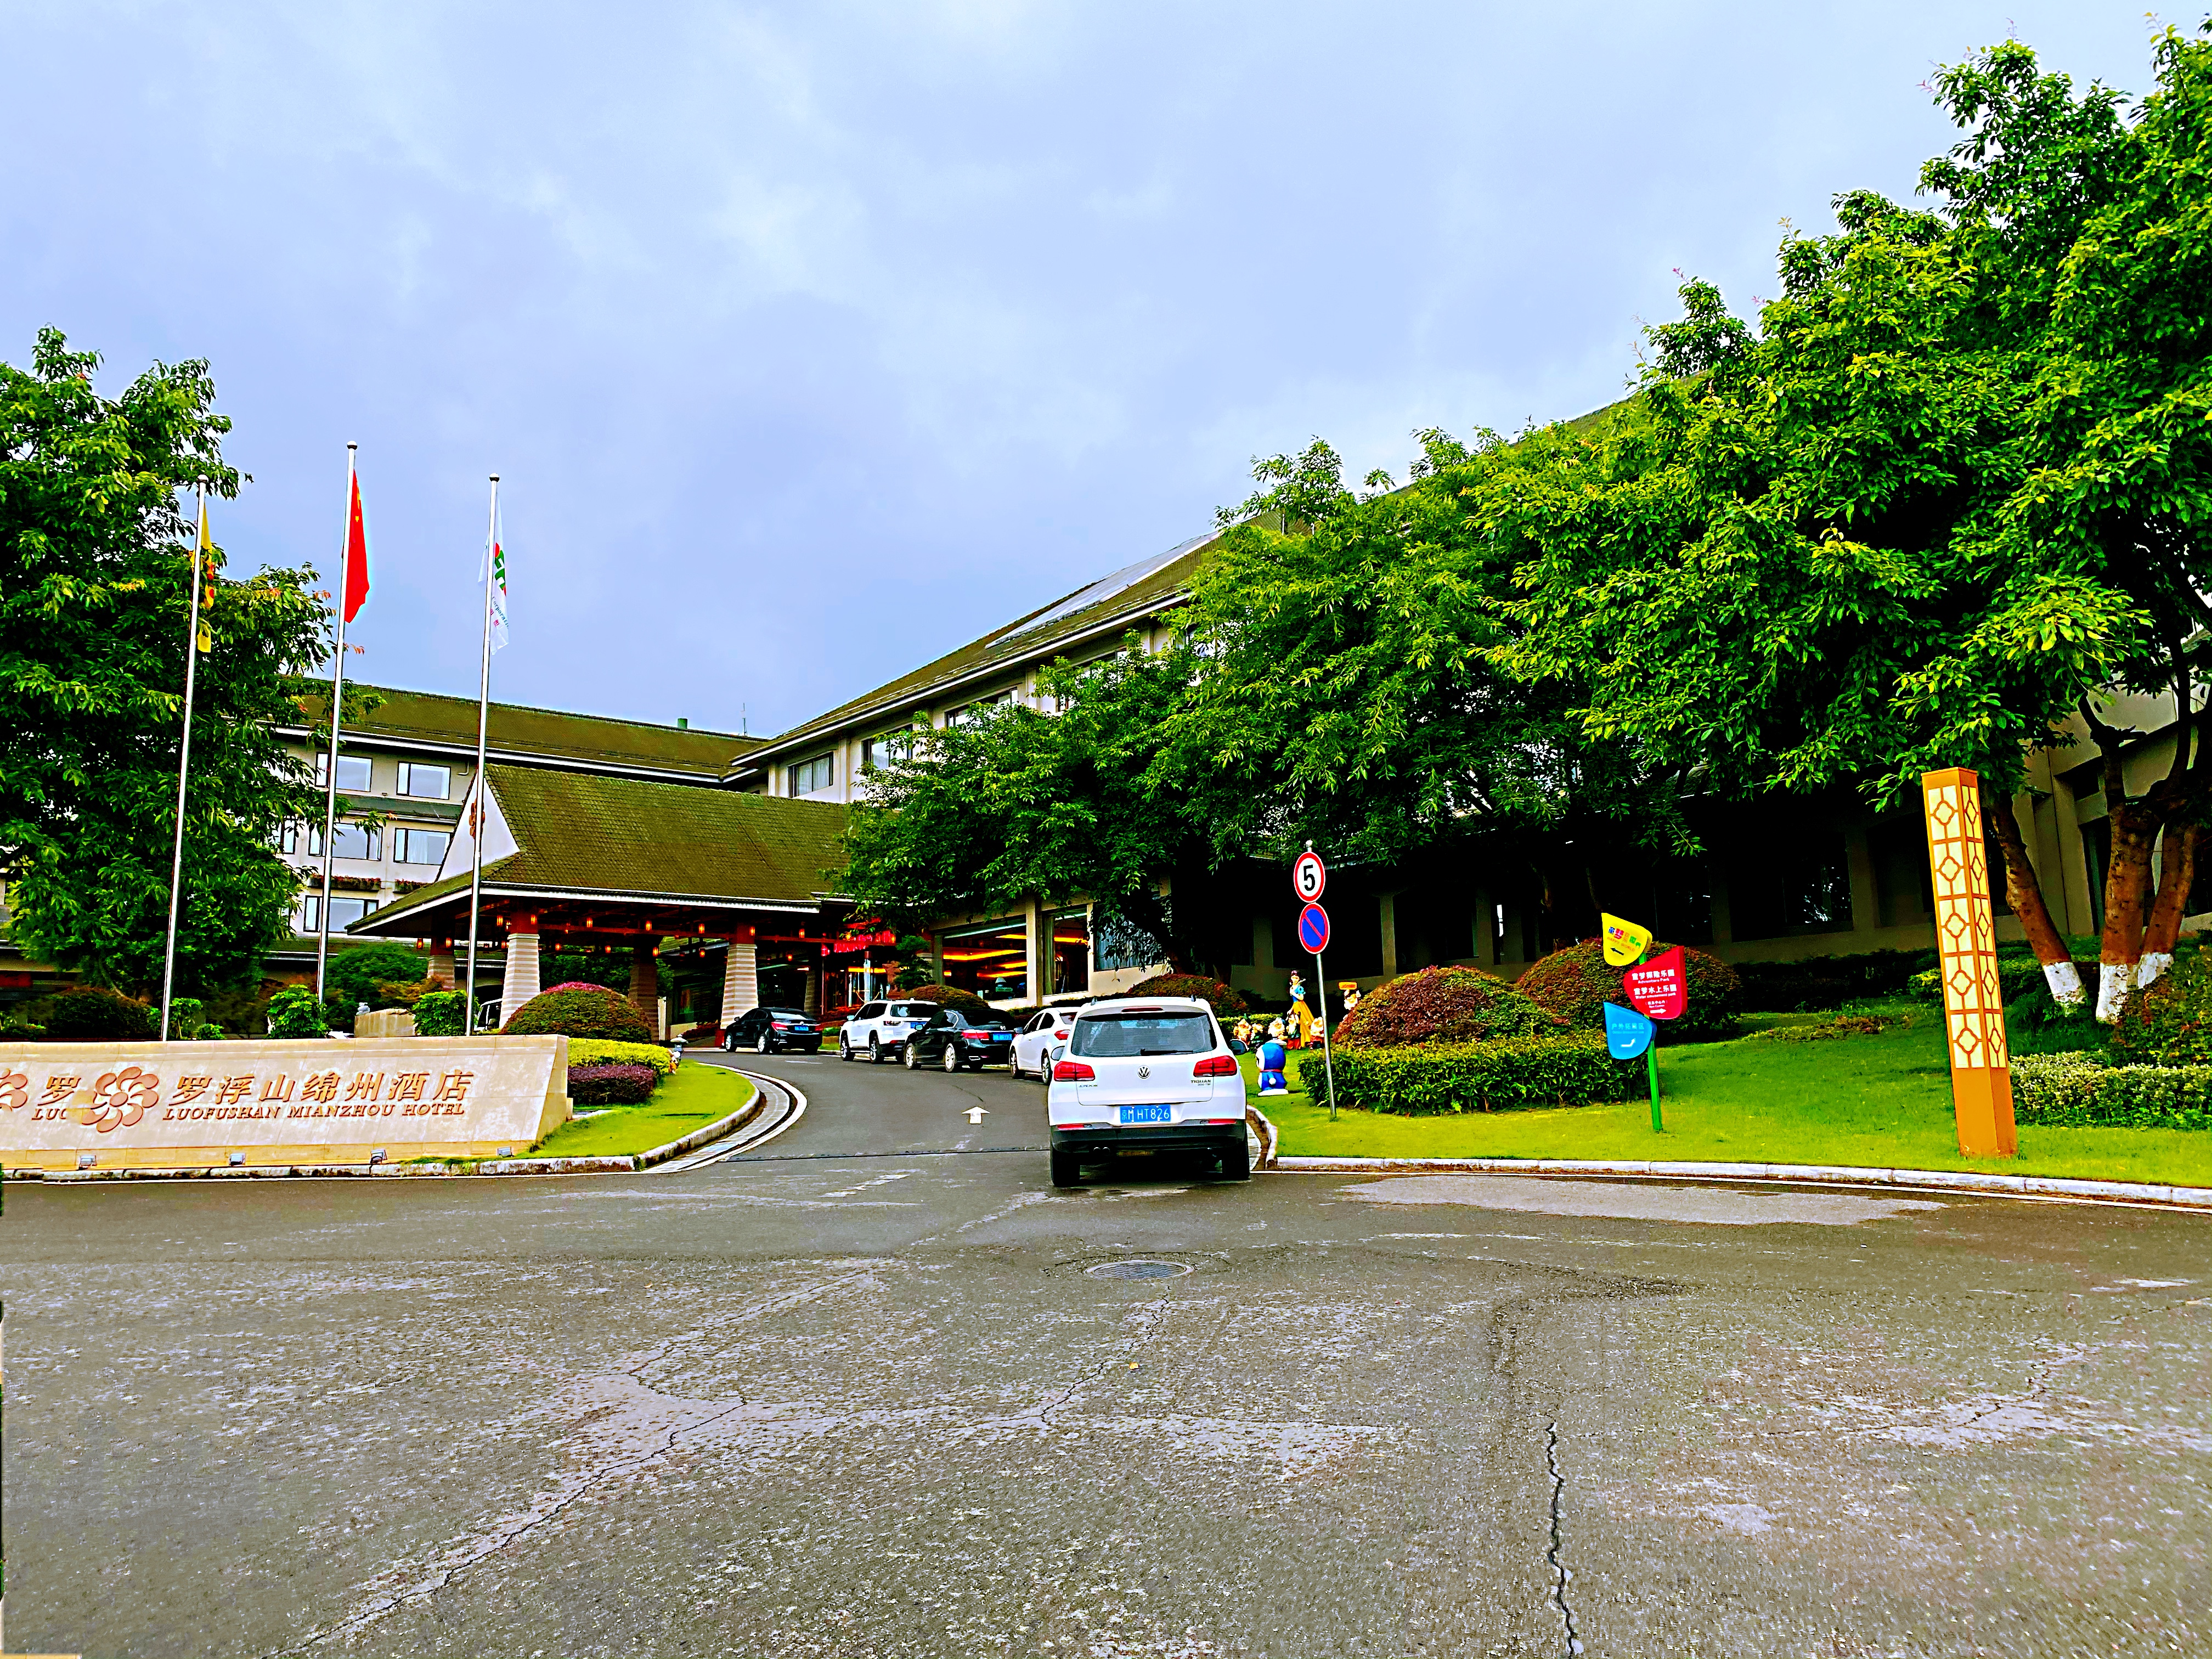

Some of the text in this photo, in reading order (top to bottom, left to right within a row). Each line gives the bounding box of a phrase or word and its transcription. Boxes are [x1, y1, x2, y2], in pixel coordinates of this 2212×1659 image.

[1304, 865, 1315, 891] 5
[168, 1069, 474, 1106] 罗浮山绵州酒店
[162, 1103, 465, 1120] LUOFUSHAN MIANZHOU HOTEL
